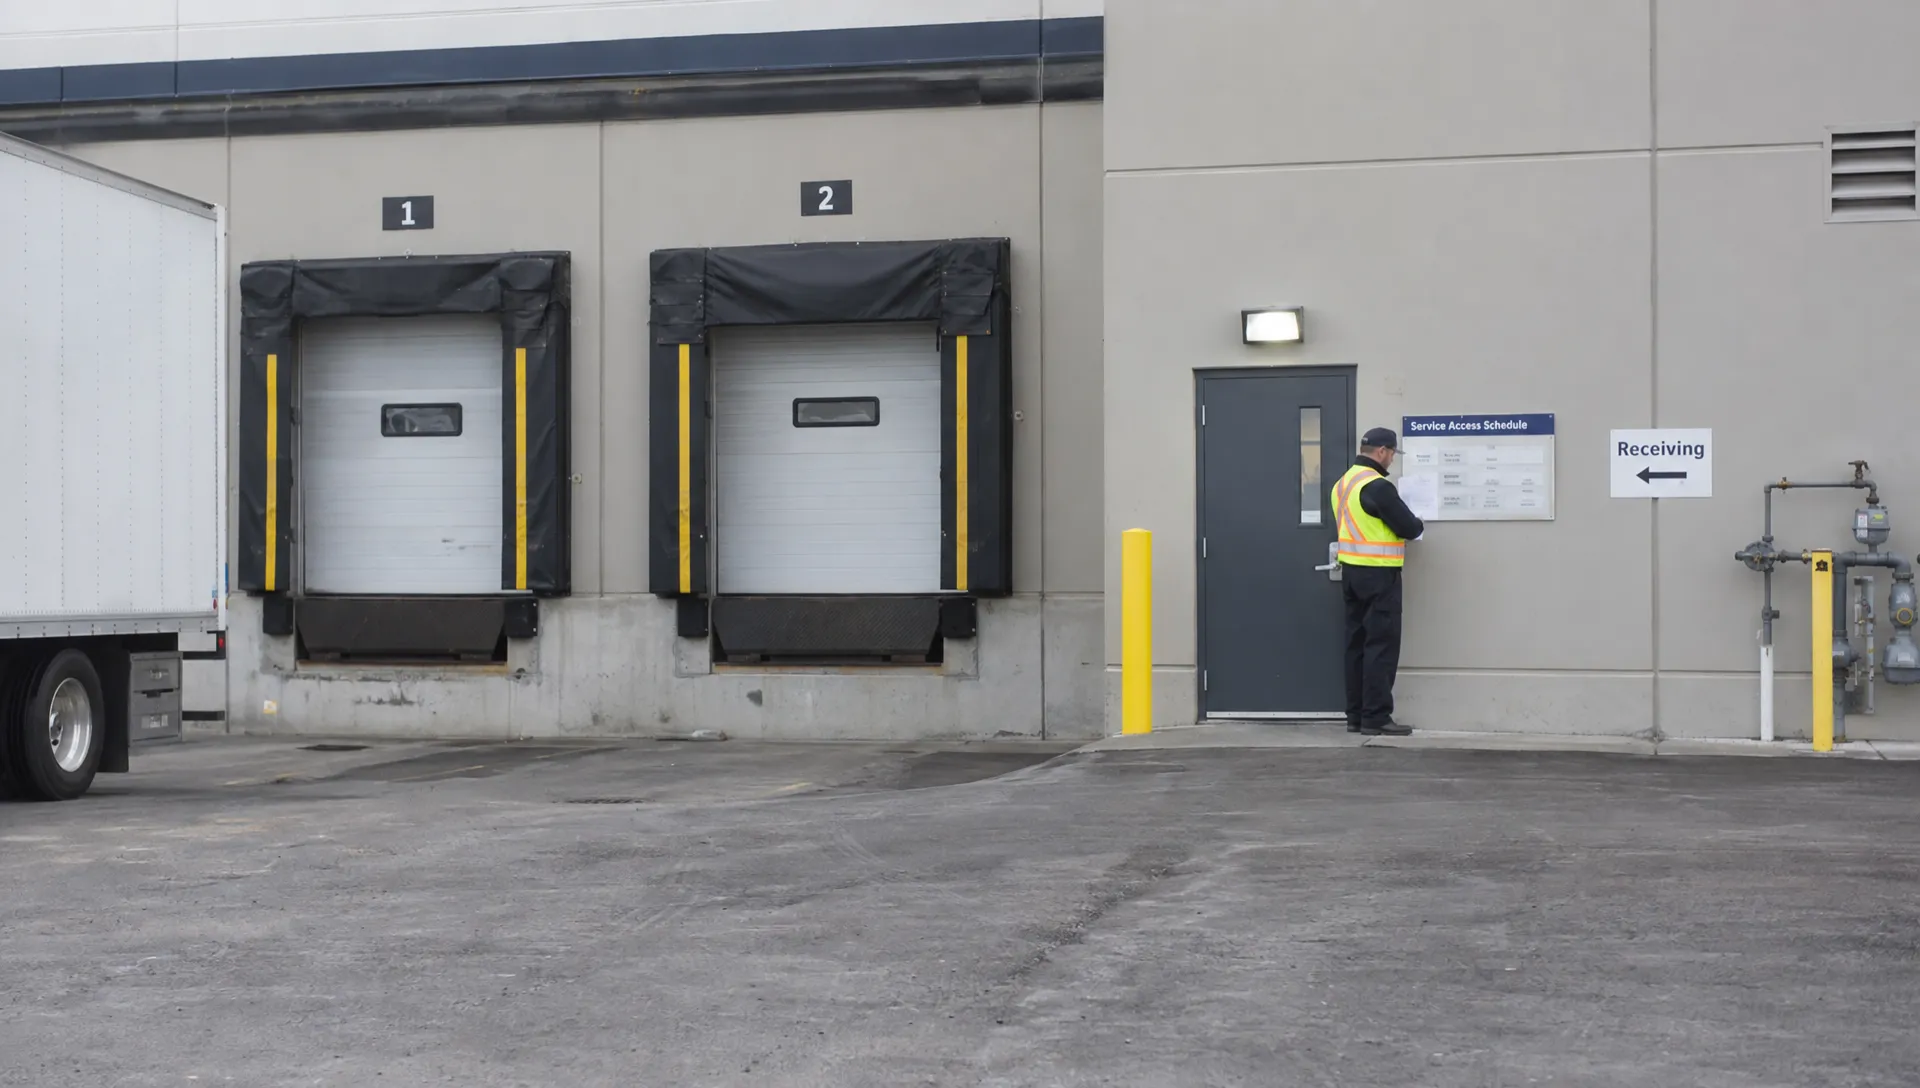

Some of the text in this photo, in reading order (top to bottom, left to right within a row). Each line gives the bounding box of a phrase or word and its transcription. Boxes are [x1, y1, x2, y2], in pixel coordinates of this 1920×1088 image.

[818, 185, 834, 211] 2
[401, 200, 416, 226] 1
[1410, 419, 1528, 431] Service Access Schedule
[1617, 440, 1705, 460] Receiving
